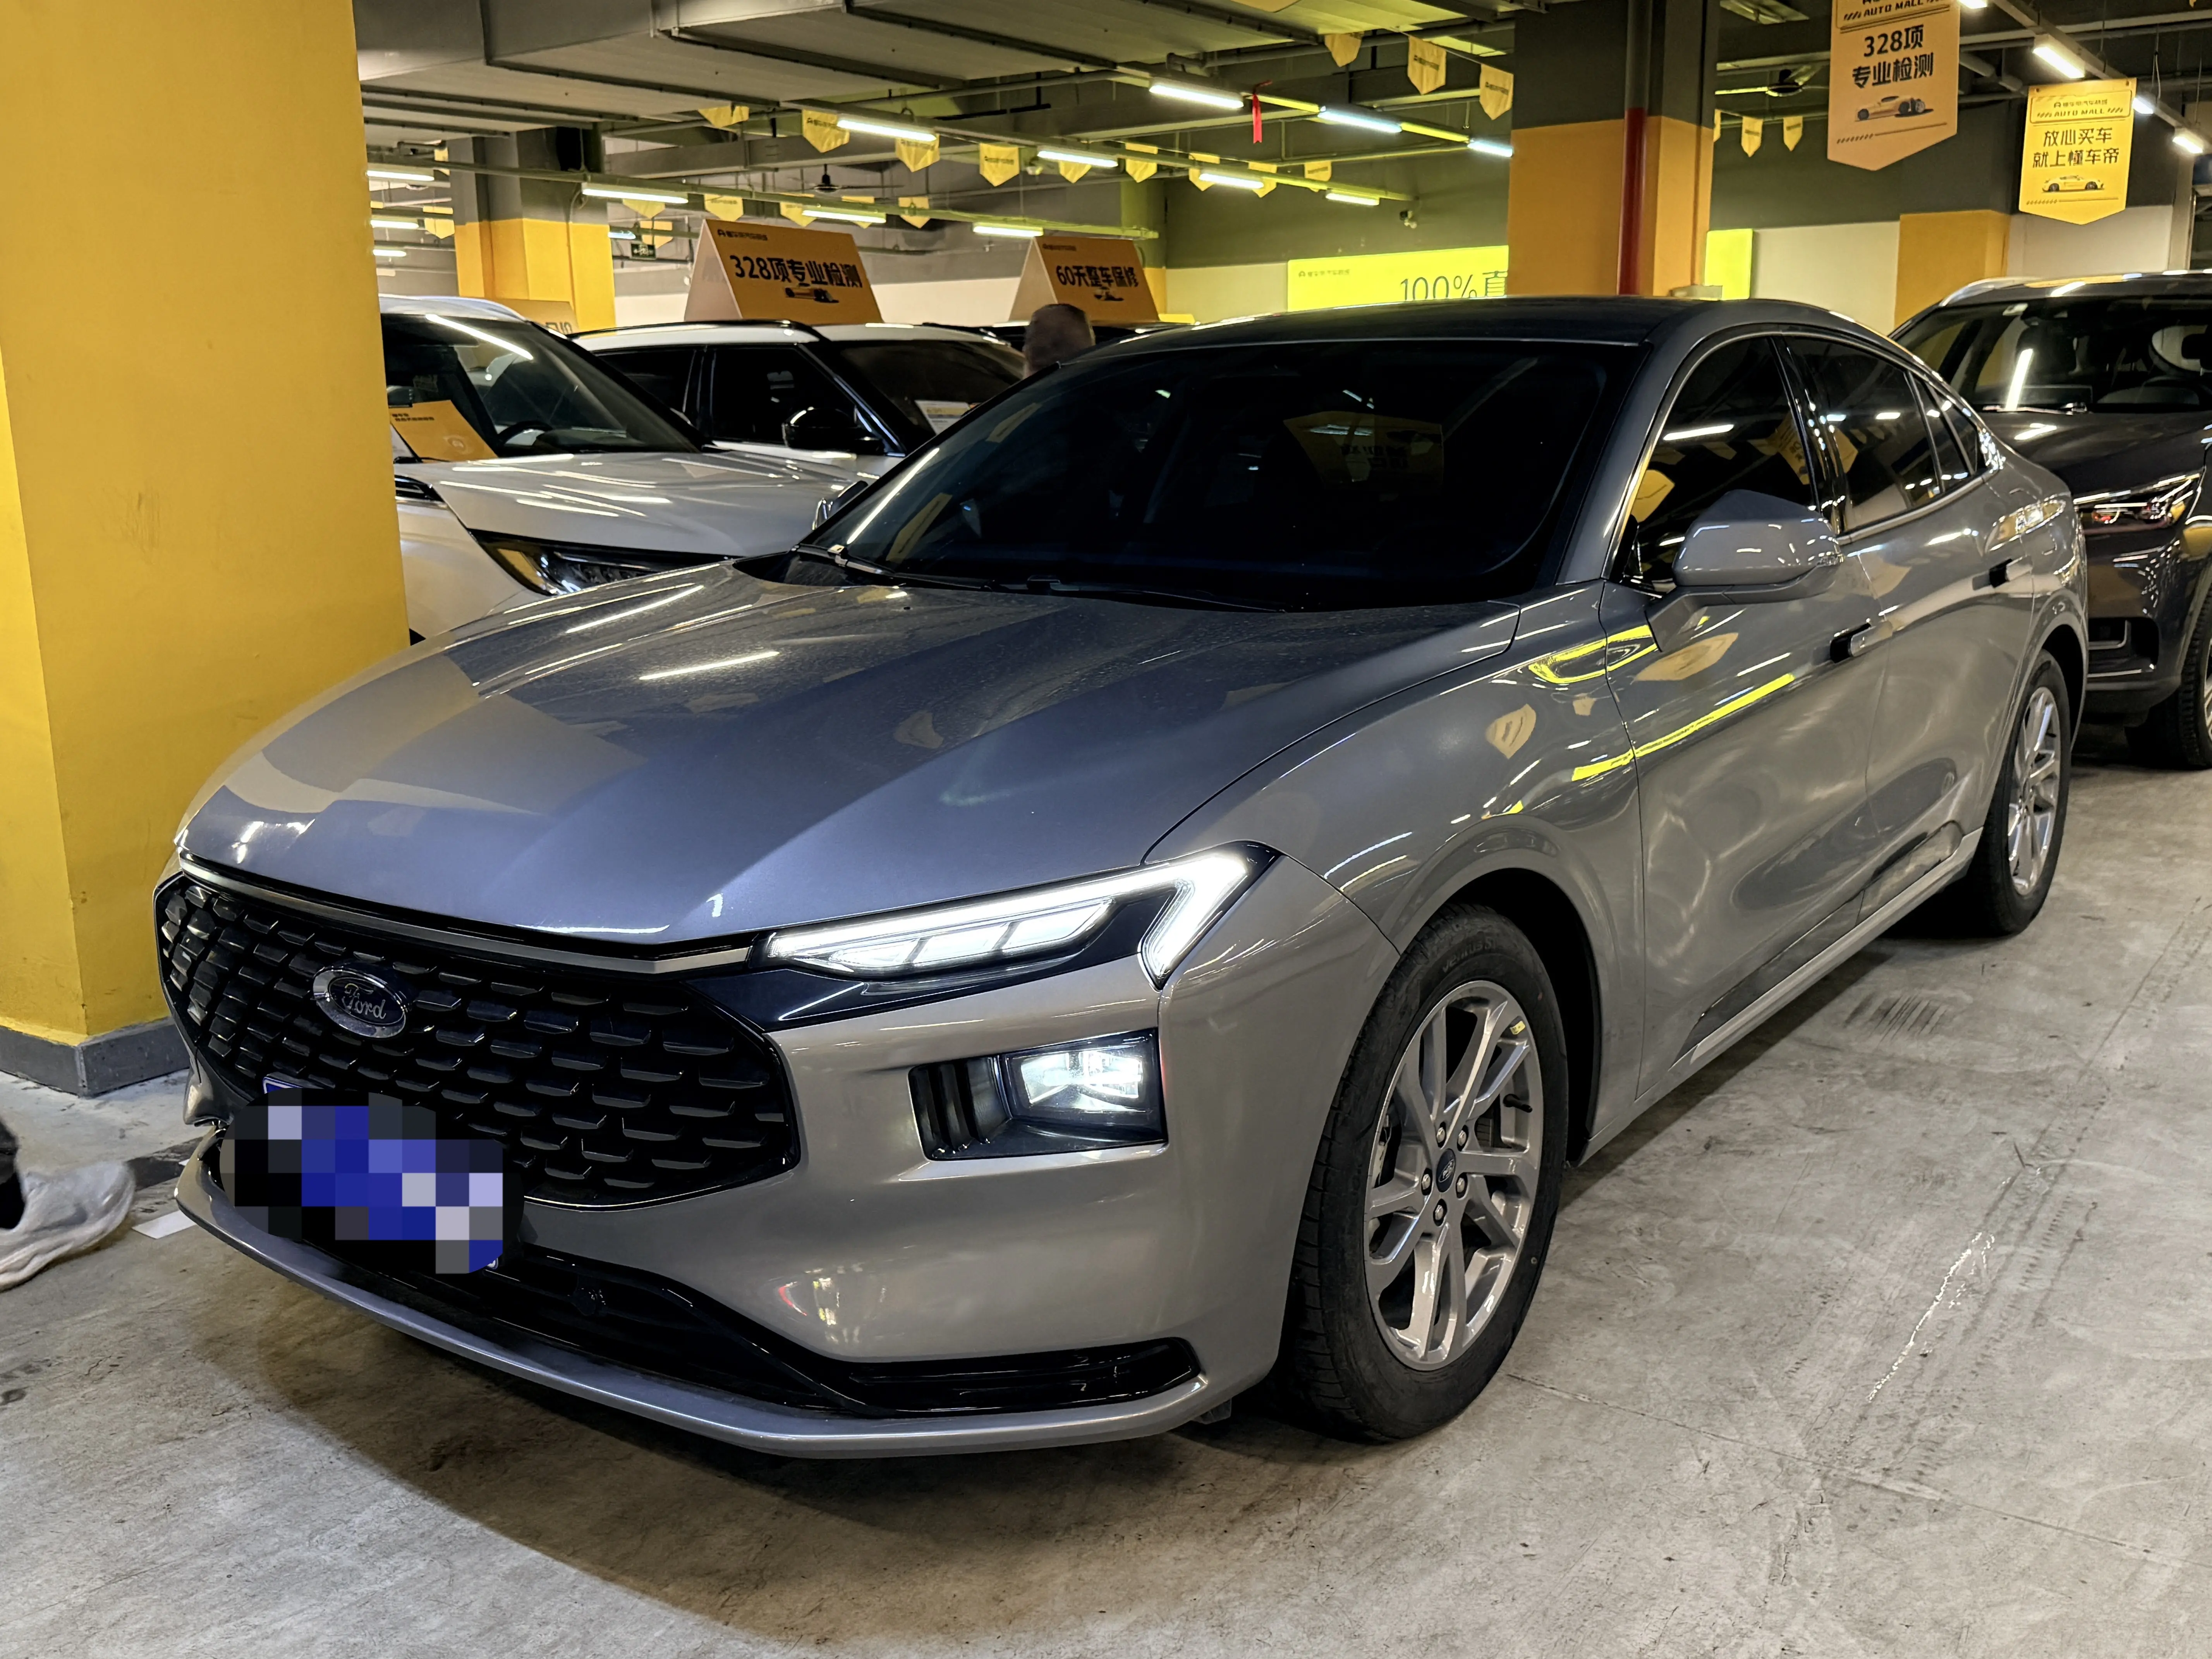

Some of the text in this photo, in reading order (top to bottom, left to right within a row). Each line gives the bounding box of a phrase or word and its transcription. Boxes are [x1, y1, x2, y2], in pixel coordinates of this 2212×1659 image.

[1863, 0, 1923, 17] AUTO MALL
[1863, 24, 1924, 57] 328项
[1852, 52, 1934, 88] 专业检测
[2043, 127, 2112, 147] 放心买车
[2033, 148, 2119, 168] 就上懂车帝
[730, 255, 863, 288] 328项专业检测
[1056, 265, 1139, 288] 60天整车保修
[341, 983, 386, 1019] Ford
